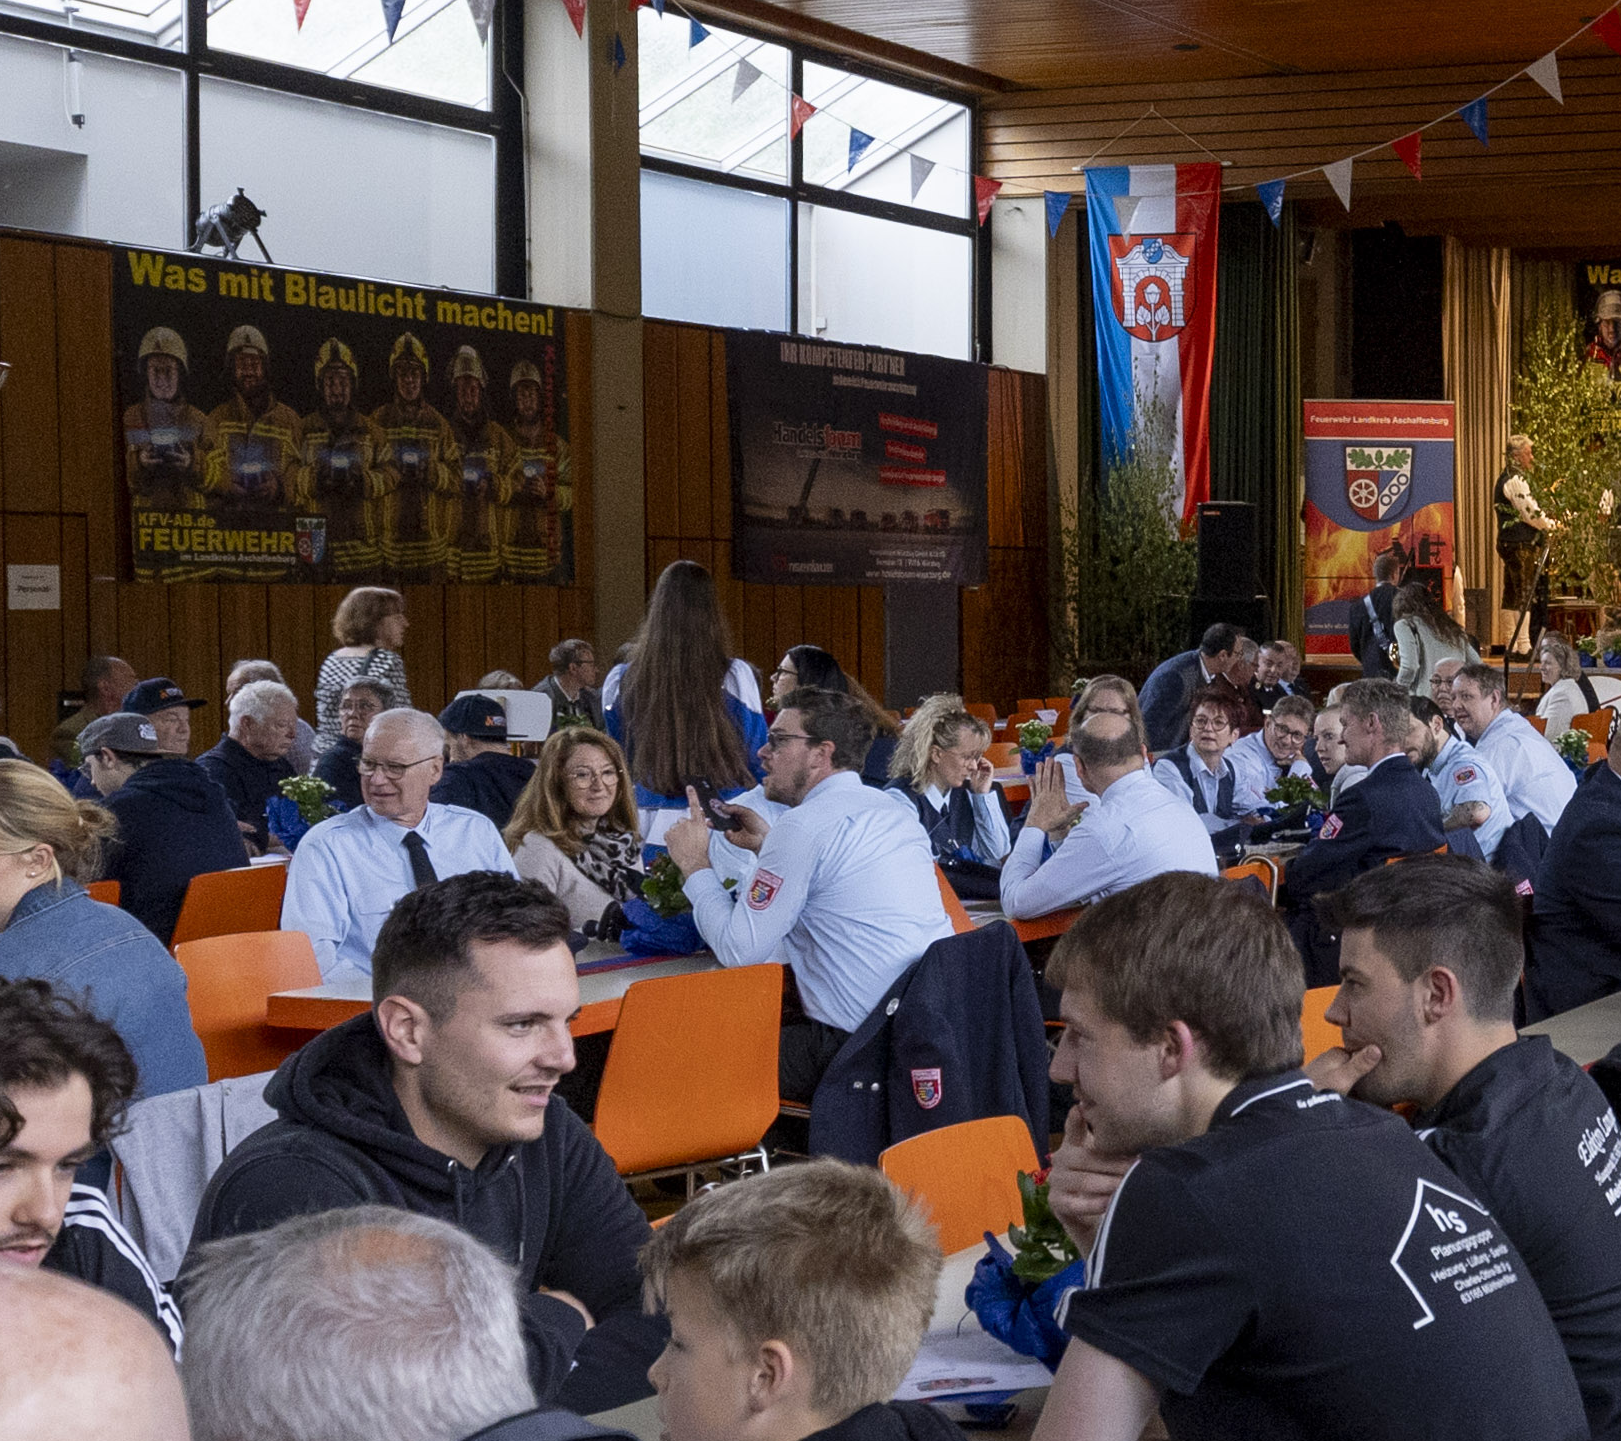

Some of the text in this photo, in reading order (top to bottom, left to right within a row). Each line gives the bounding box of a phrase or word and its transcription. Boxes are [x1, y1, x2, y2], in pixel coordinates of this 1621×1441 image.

[127, 250, 555, 338] Was mit Blaulicht machen!
[1310, 415, 1449, 426] Feuerwehr Landkreis Aschaffenburg
[138, 512, 216, 528] KFV-AB.de
[138, 528, 296, 553] FEUERWEHR
[1425, 1203, 1468, 1234] hs
[1430, 1262, 1466, 1284] Heizung
